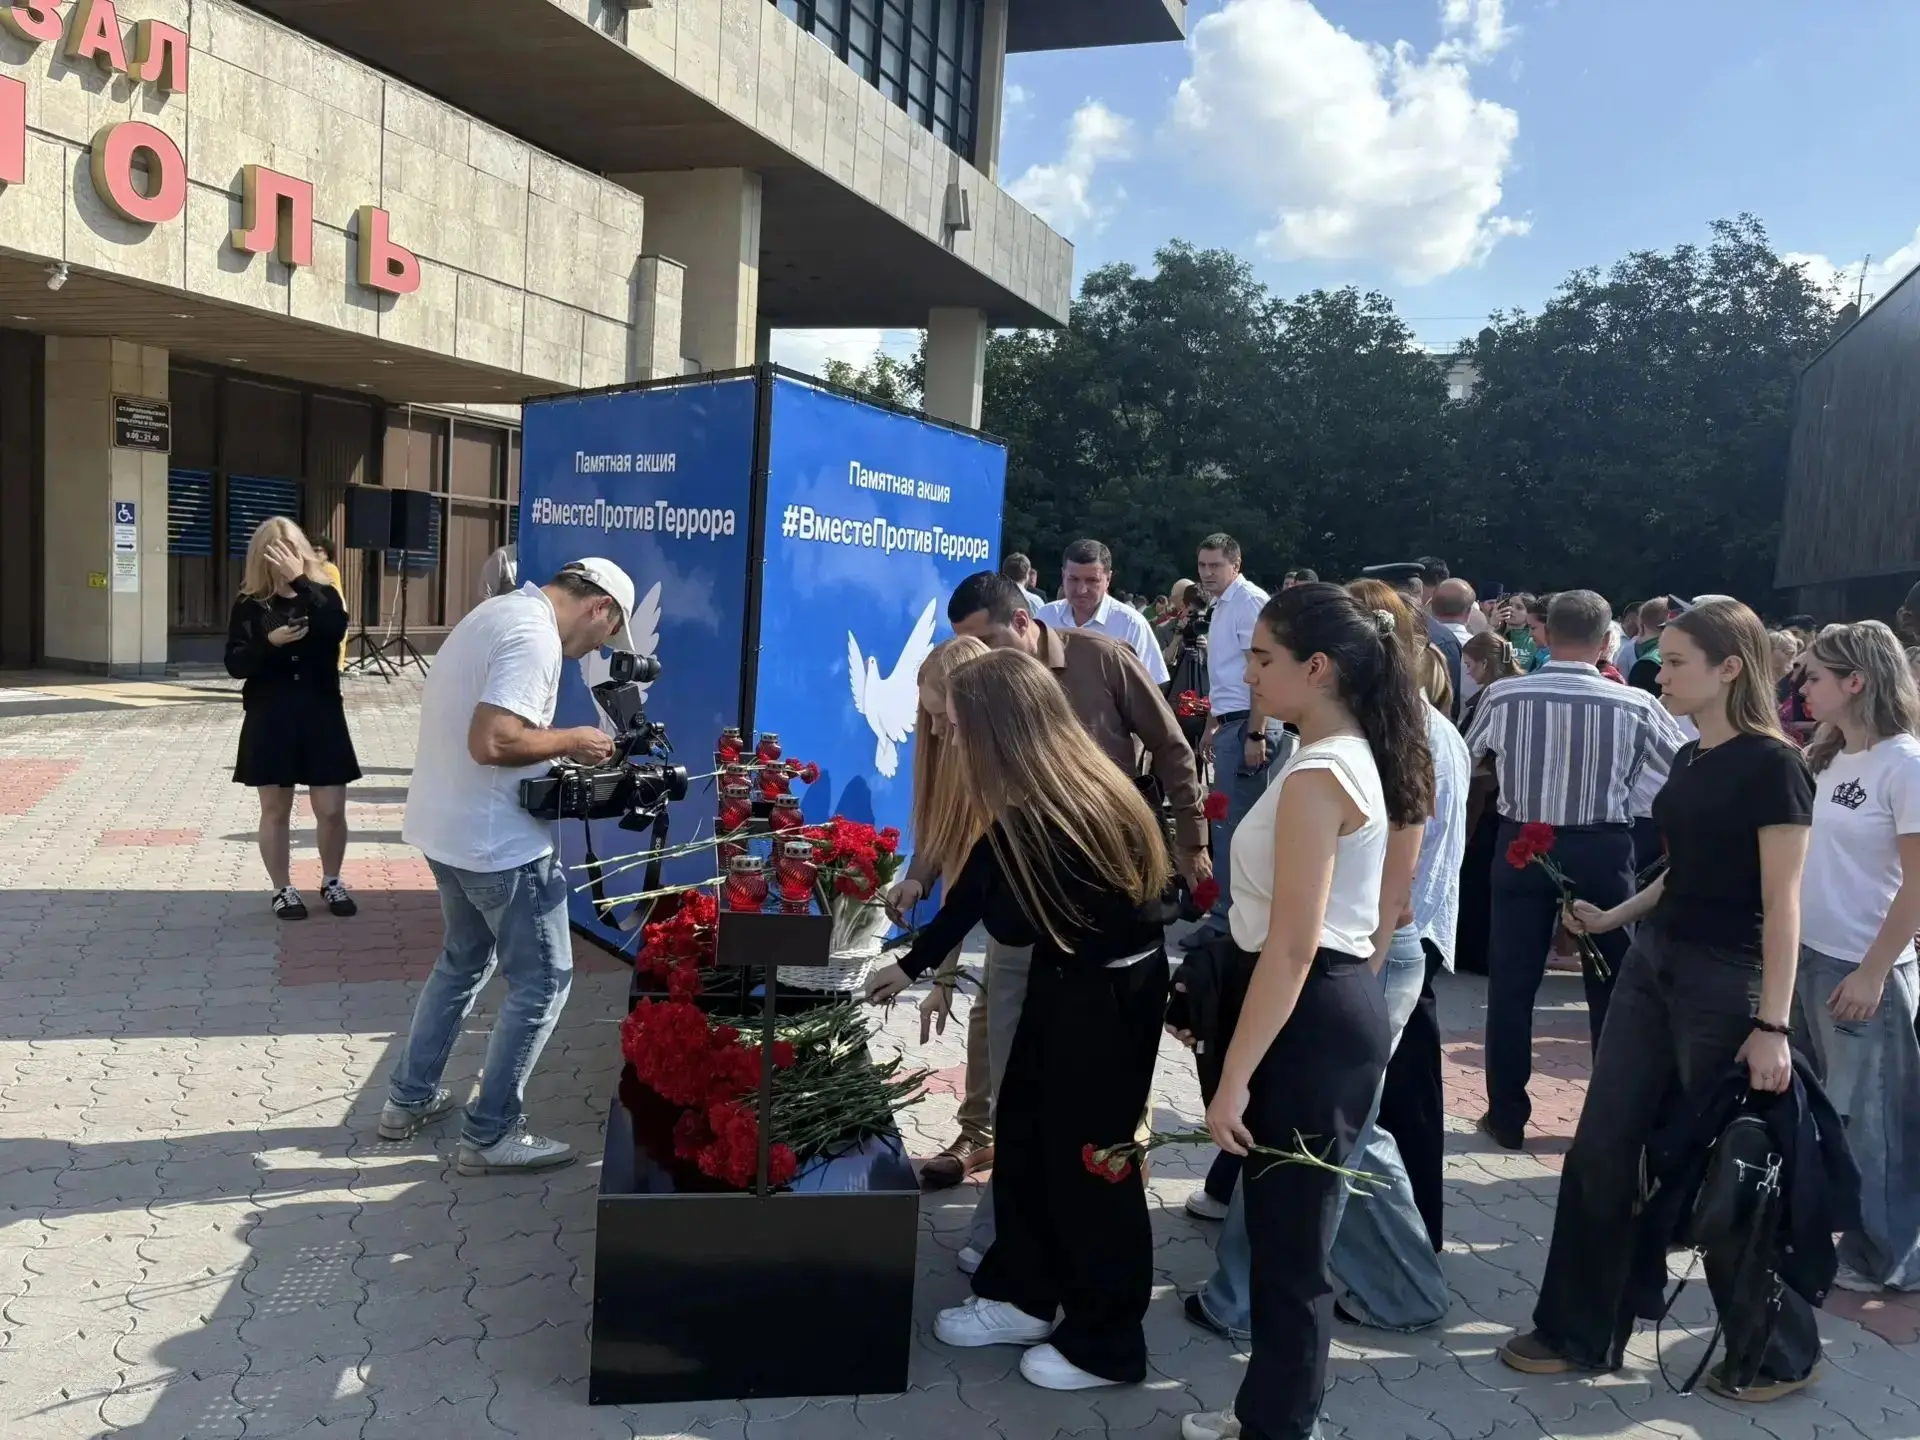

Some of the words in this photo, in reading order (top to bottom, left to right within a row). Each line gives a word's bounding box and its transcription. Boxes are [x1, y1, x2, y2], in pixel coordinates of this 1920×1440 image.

[575, 451, 631, 474] Памятная
[635, 452, 676, 473] акция
[849, 460, 914, 496] Памятная
[917, 479, 951, 503] акция
[531, 497, 736, 541] #ВместеПротивТеррора
[781, 504, 990, 564] #ВместеПротивТеррора
